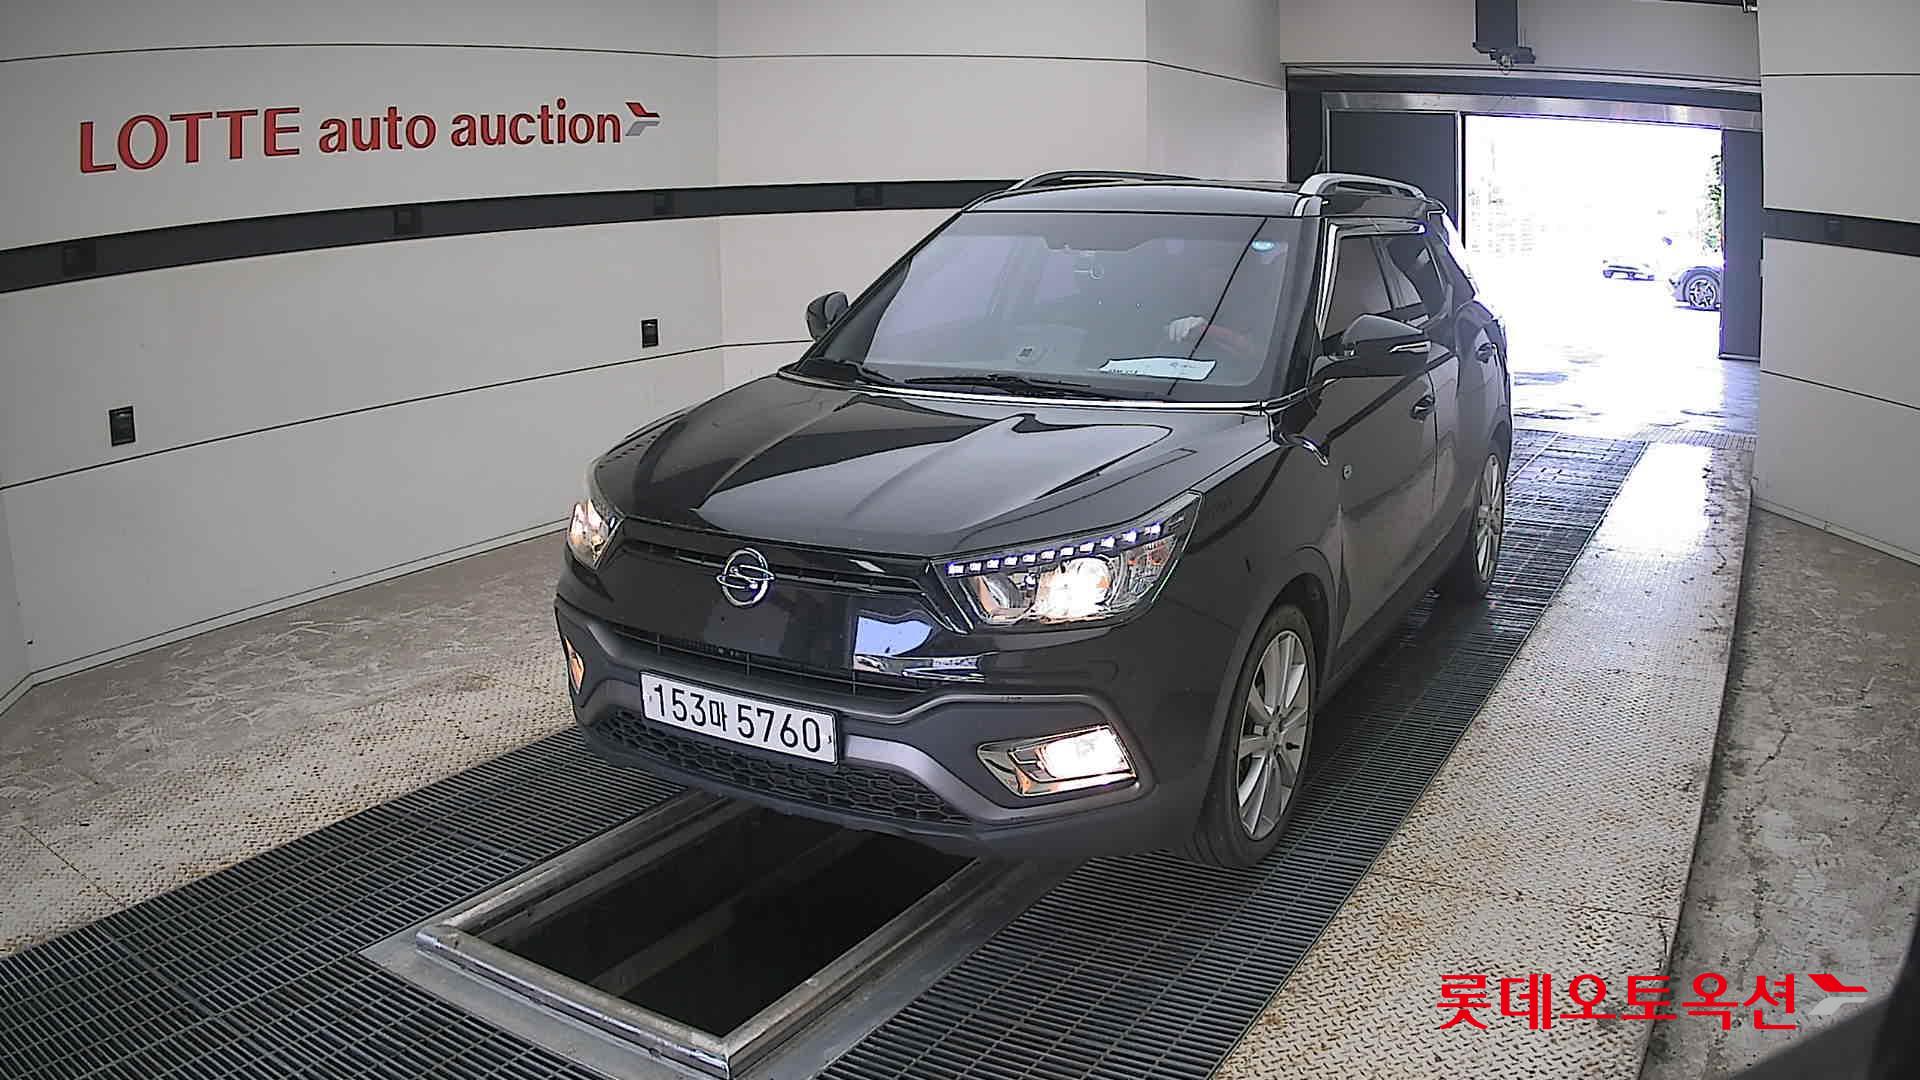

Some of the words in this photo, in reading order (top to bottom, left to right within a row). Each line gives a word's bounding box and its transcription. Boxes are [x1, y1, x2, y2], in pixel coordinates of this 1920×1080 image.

[79, 106, 301, 174] LOTTE
[318, 107, 436, 153] auto
[449, 98, 622, 147] auction
[654, 683, 728, 731] 153마
[737, 703, 821, 753] 5760
